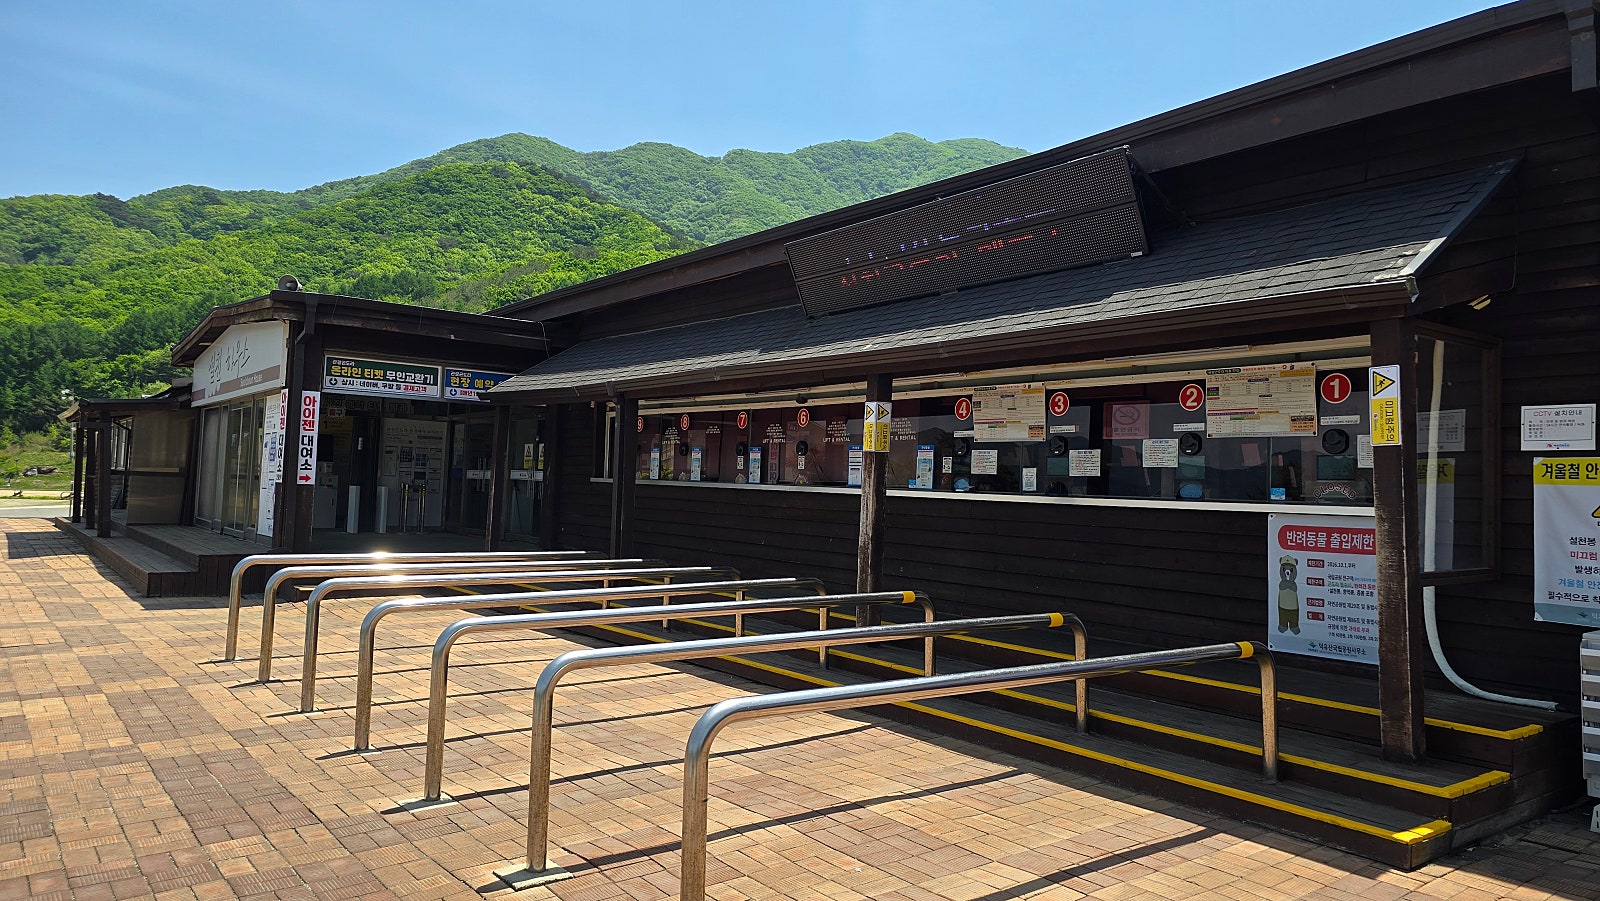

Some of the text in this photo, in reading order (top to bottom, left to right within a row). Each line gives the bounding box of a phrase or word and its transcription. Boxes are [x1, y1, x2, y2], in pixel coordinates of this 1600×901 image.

[330, 365, 434, 385] 온라인 티켓 무인교환기
[450, 376, 471, 388] 현장
[1185, 387, 1198, 407] 2
[1329, 378, 1340, 399] 1
[1385, 400, 1395, 442] 미끄럼주의
[1553, 409, 1583, 417] 설치안내
[299, 395, 317, 471] 아이젠 대여소
[1541, 463, 1580, 480] 겨울철
[1313, 482, 1357, 500] CLOSED
[1286, 530, 1375, 550] 반려동물 출입제한
[1569, 536, 1597, 547] 설천봉
[1569, 550, 1598, 561] 미끄럼
[1558, 578, 1584, 589] 겨울철
[1547, 590, 1590, 603] 필수적으로
